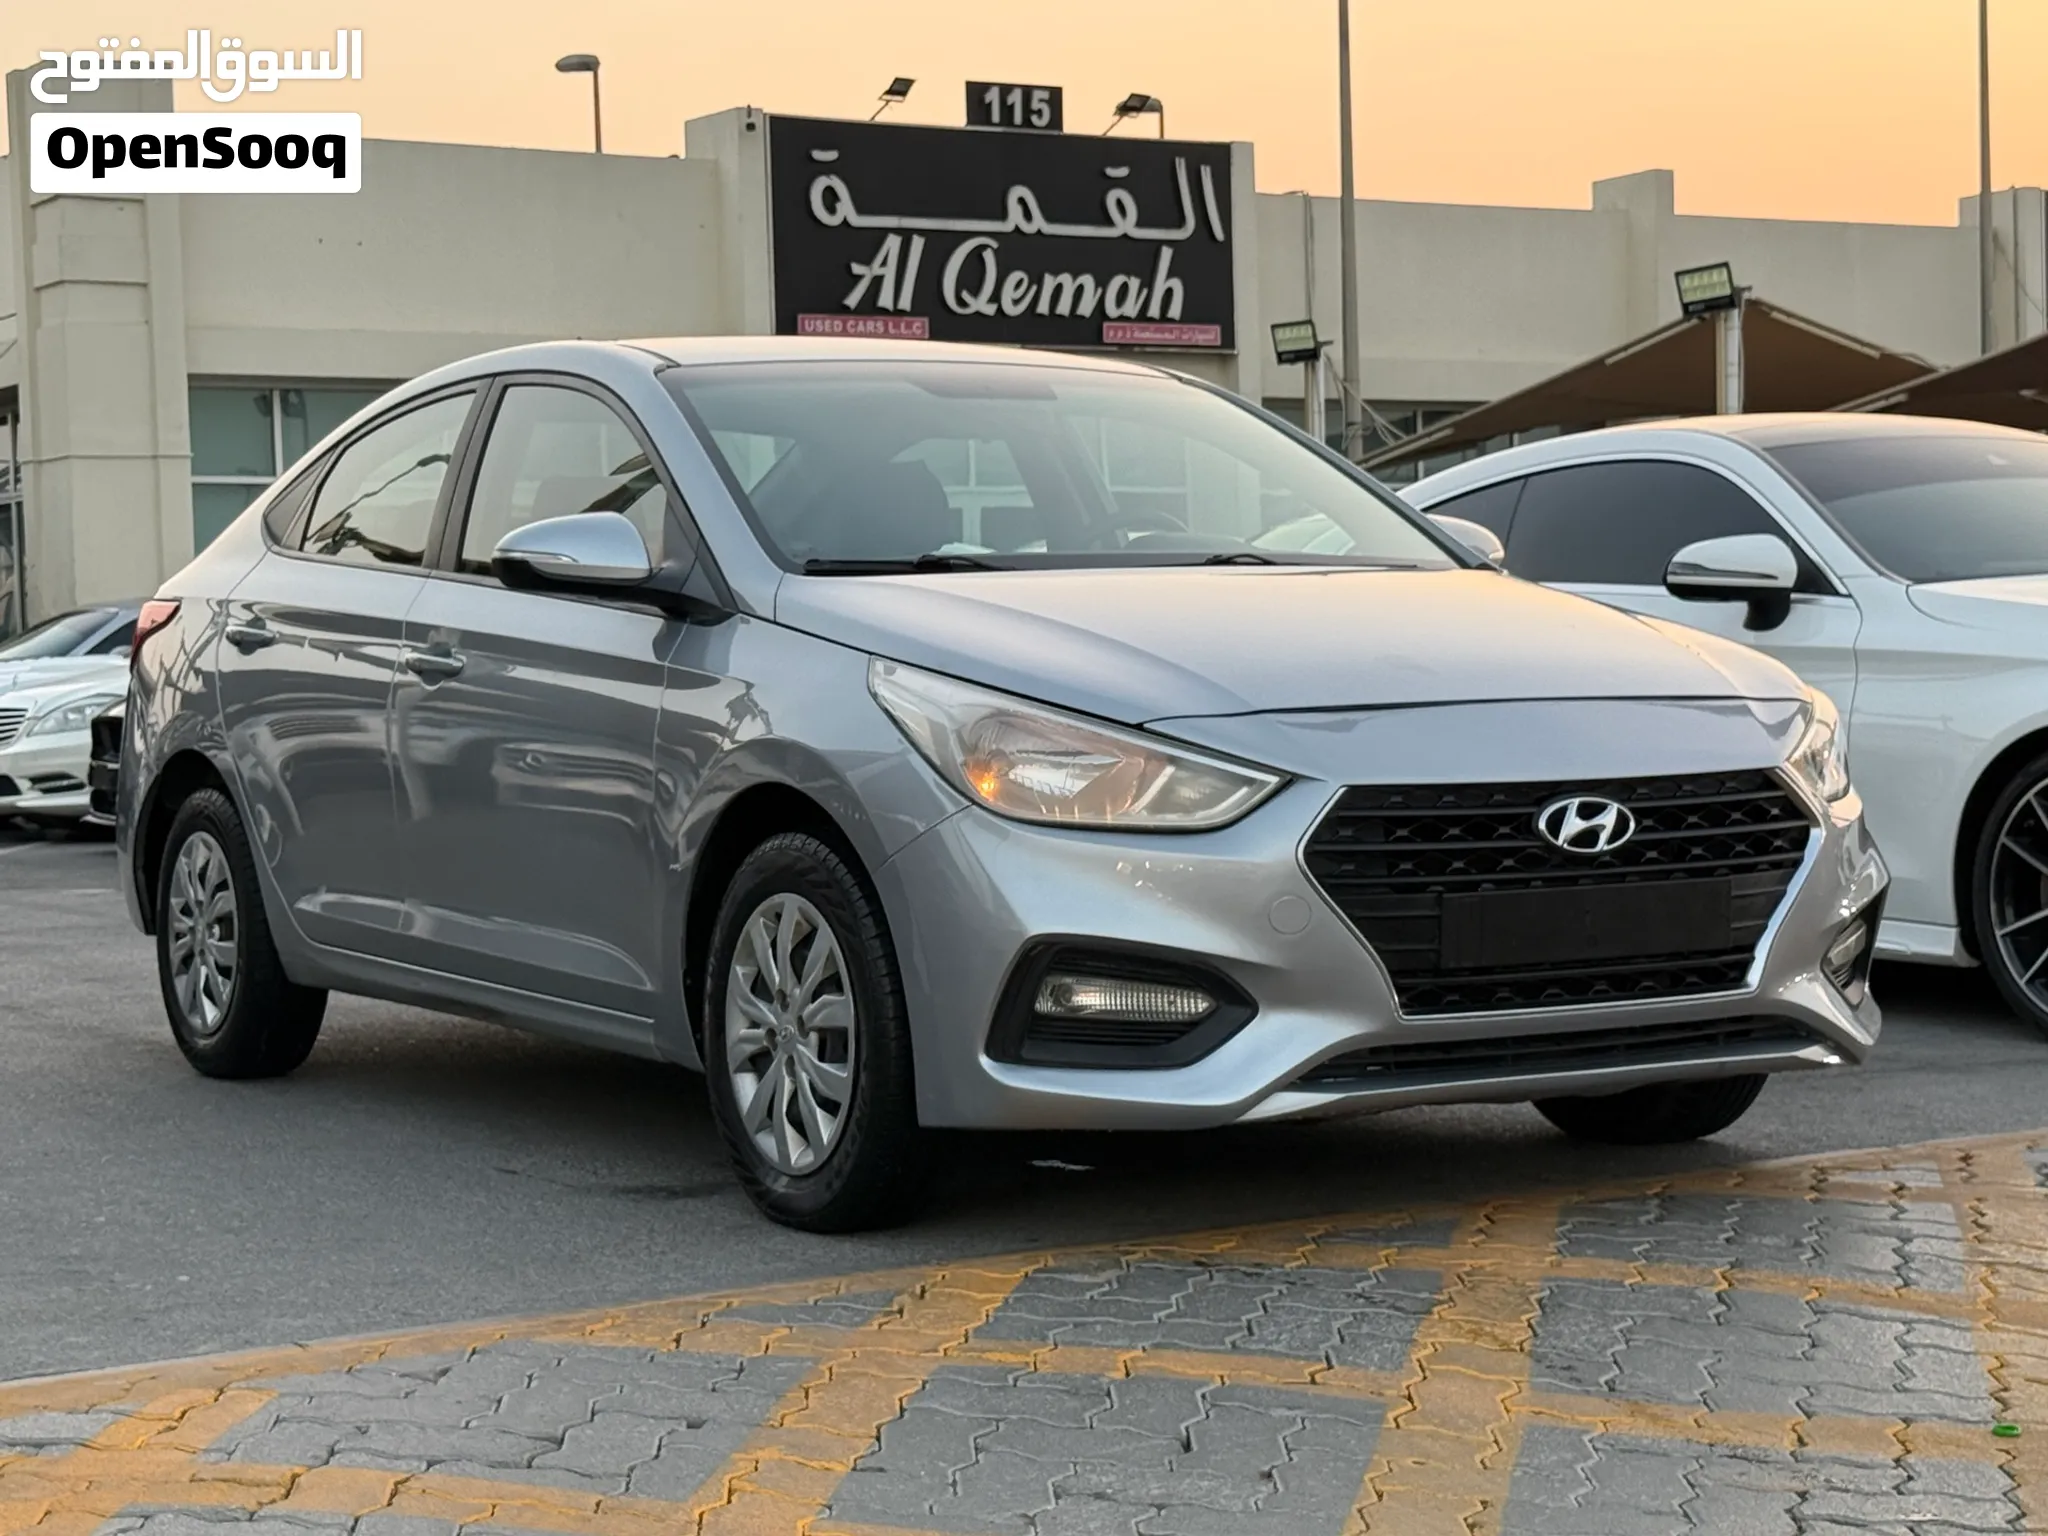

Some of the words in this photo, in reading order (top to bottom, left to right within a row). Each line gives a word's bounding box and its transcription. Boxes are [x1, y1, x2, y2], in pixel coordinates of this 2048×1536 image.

[983, 86, 1051, 128] 115
[808, 149, 1225, 243] القمة
[842, 232, 926, 313] Al
[941, 236, 1185, 320] Qemah
[804, 318, 843, 333] USED
[846, 319, 885, 334] CARS
